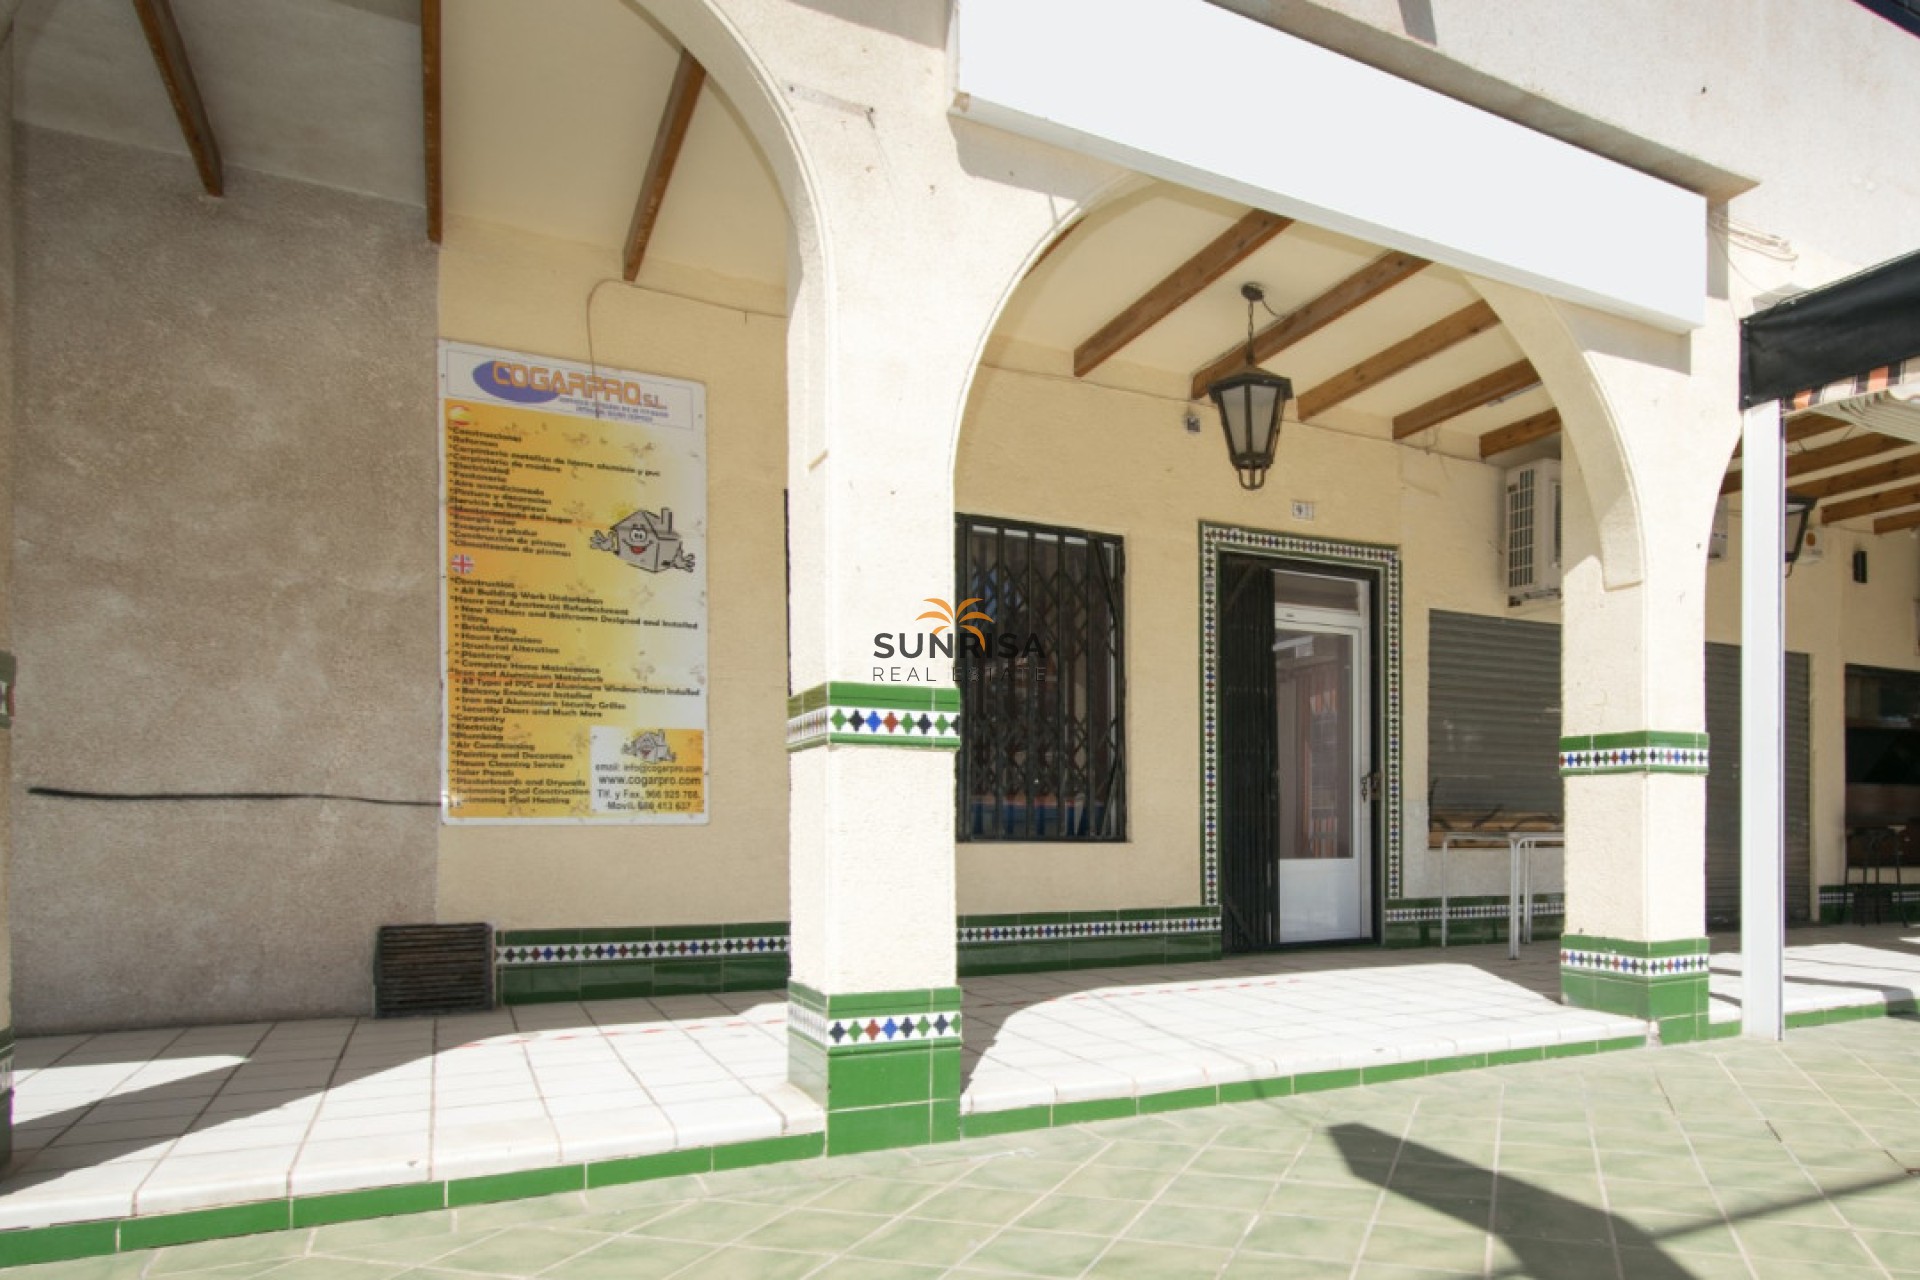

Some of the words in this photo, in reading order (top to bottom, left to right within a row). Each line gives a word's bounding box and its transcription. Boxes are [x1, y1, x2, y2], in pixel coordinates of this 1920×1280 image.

[493, 360, 641, 406] COGARPRO
[477, 588, 518, 600] Building
[520, 592, 547, 600] Work
[461, 605, 483, 613] New
[528, 610, 547, 618] and
[600, 615, 641, 625] Designed
[662, 620, 698, 630] Installed
[461, 650, 511, 662] Plastering
[510, 663, 539, 671] Home
[514, 680, 535, 688] PVC
[461, 688, 500, 696] Balcony
[502, 706, 529, 714] Doors
[552, 708, 577, 716] Much
[456, 713, 506, 724] Carpentry
[456, 722, 504, 732] Electricity
[488, 760, 531, 769] Cleaning
[598, 776, 702, 787] www.cogarpro.com
[508, 786, 531, 796] Pool
[533, 786, 591, 796] Construction
[508, 796, 531, 805] Pool
[533, 796, 570, 806] Heating
